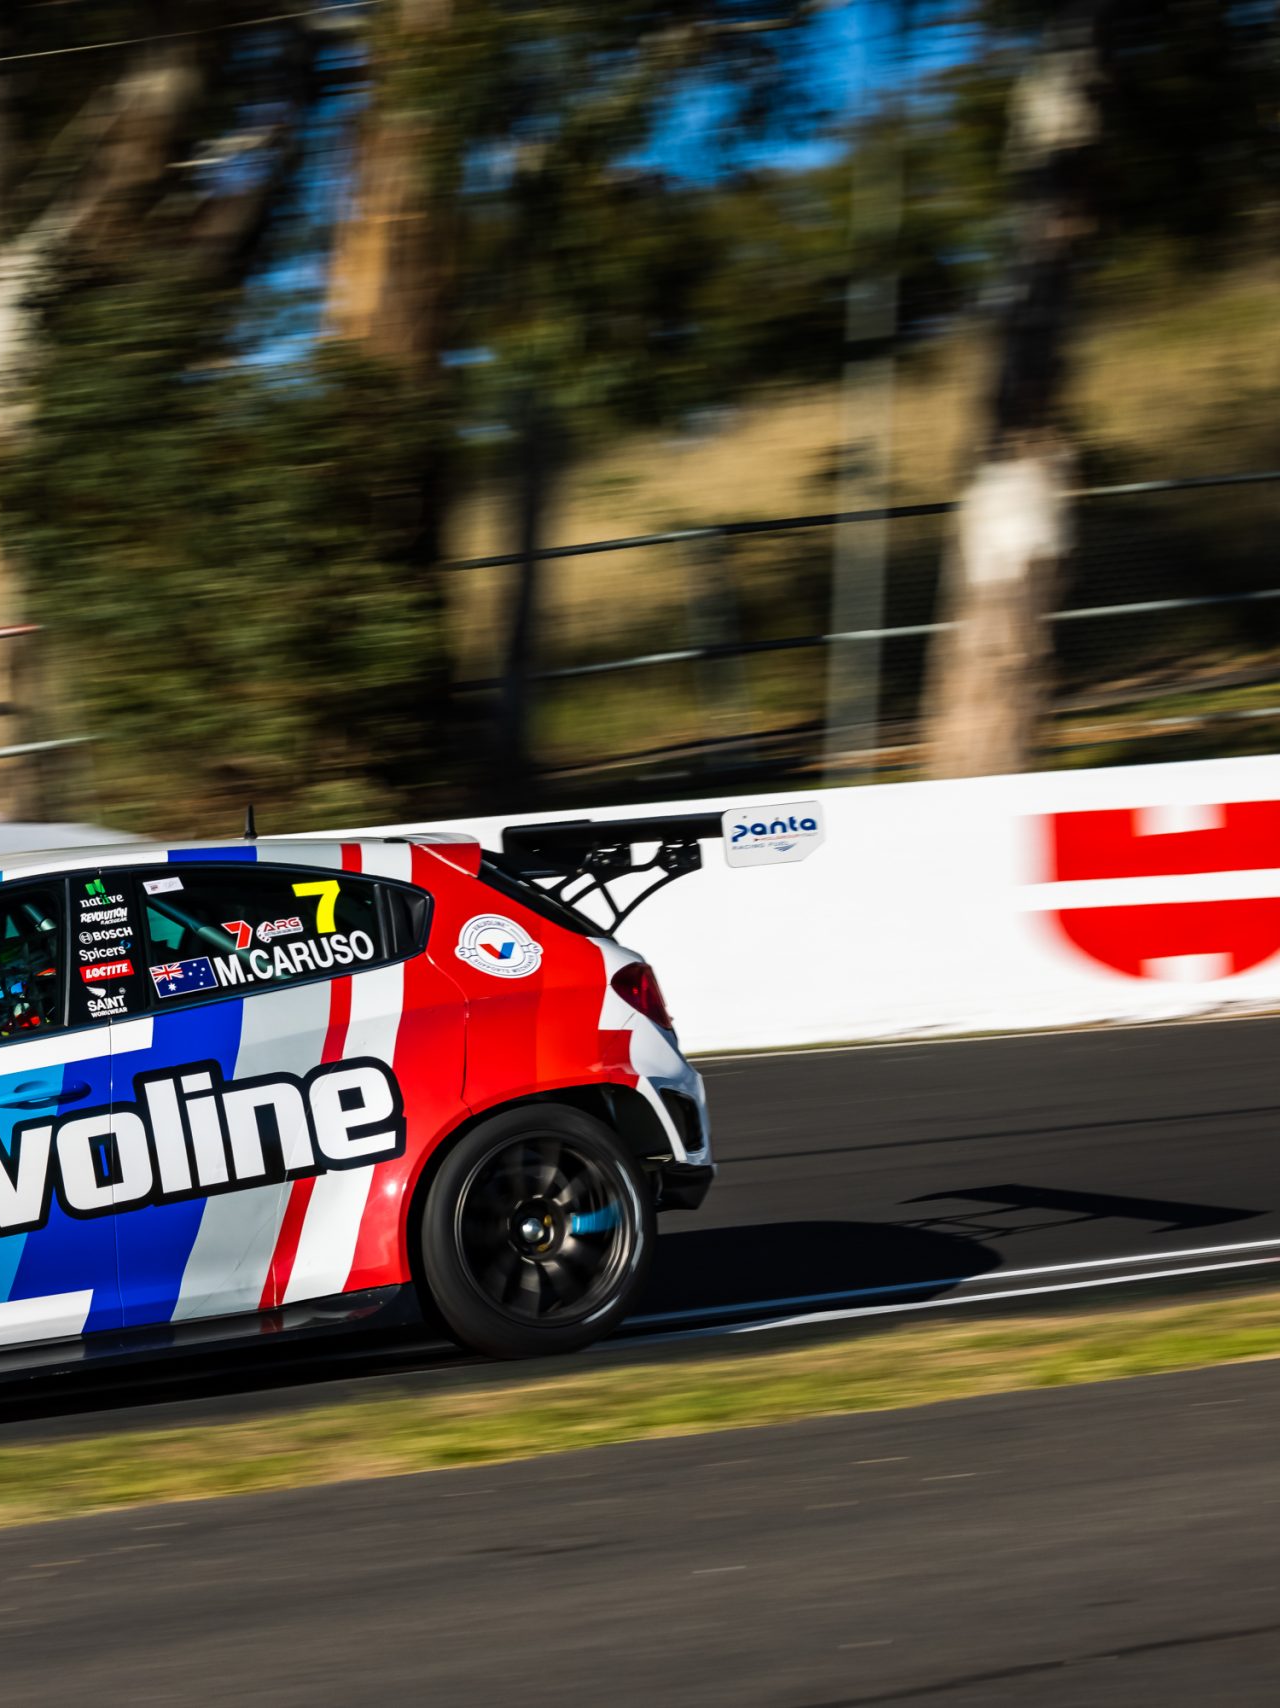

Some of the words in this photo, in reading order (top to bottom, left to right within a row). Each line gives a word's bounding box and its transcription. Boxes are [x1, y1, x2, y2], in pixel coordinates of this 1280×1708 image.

[731, 816, 817, 843] panta
[79, 894, 124, 908] natiive
[292, 880, 341, 934] 7
[80, 907, 128, 923] REVOLUTION
[263, 917, 300, 932] ARG
[92, 926, 133, 941] BOSCH
[79, 946, 127, 962] Spicers
[213, 930, 375, 987] M.CARUSO
[85, 963, 129, 979] LOCTITE
[87, 995, 125, 1012] SAINT
[91, 1007, 128, 1018] WORKWEAR
